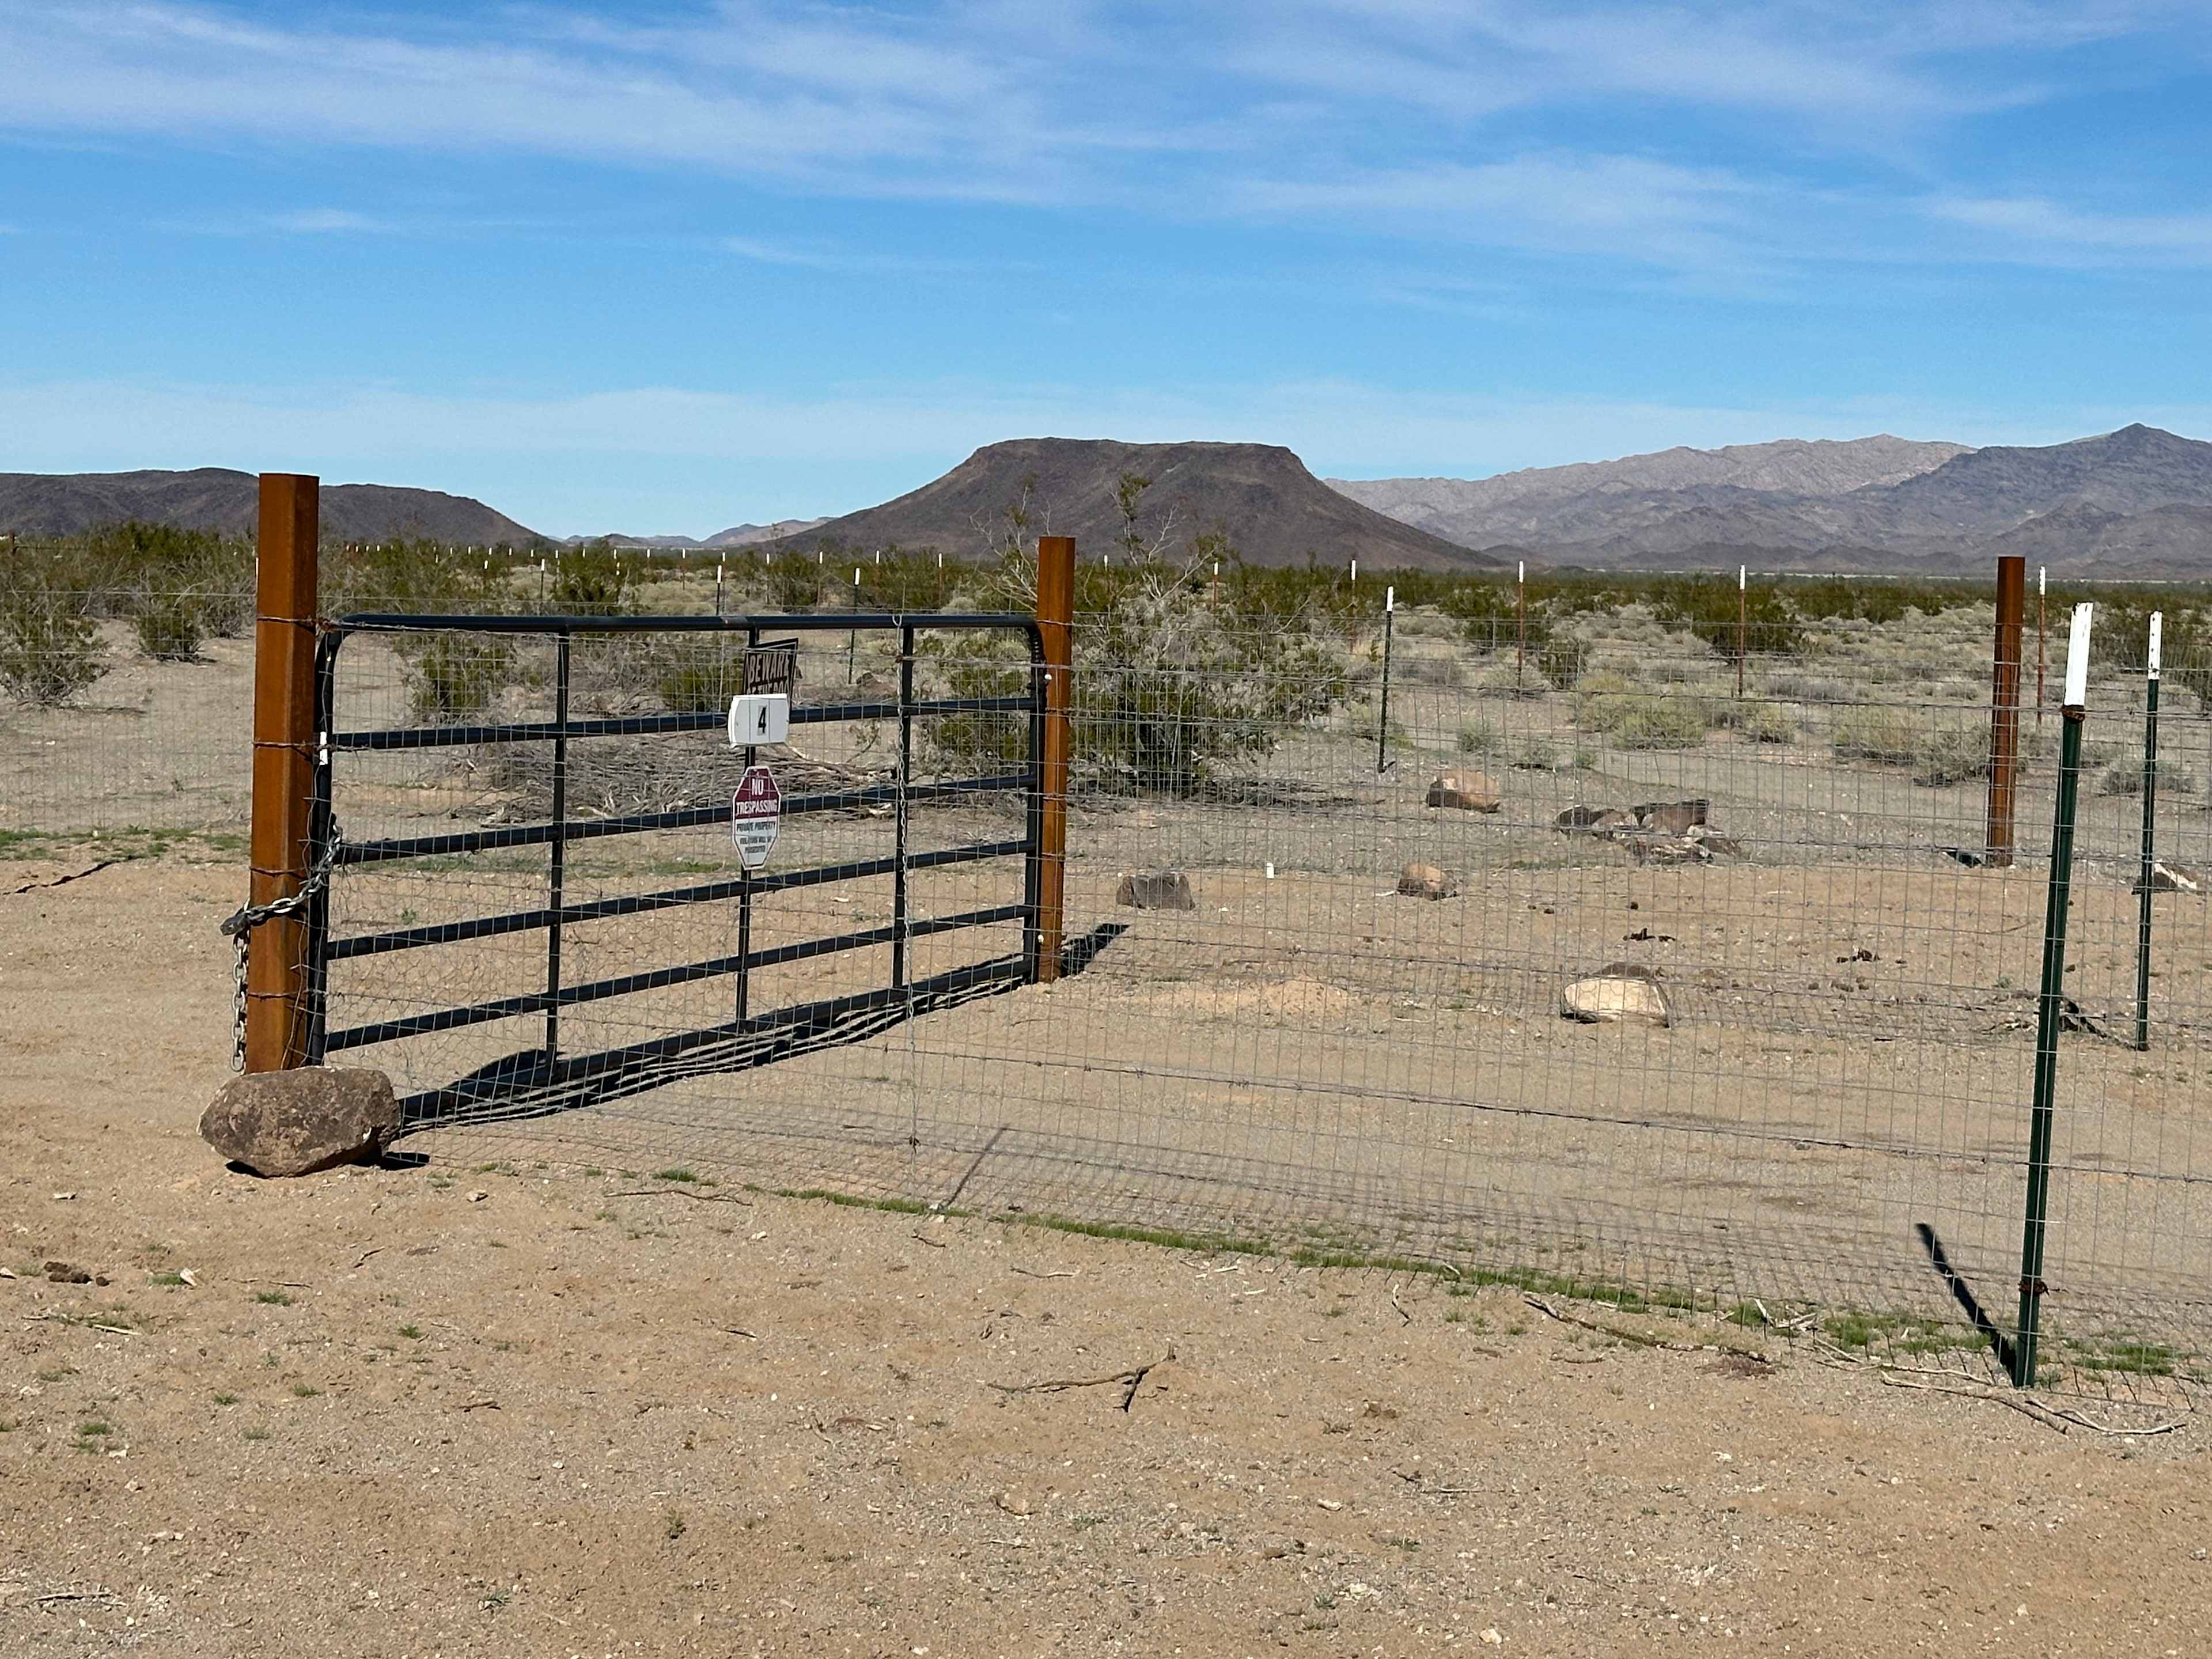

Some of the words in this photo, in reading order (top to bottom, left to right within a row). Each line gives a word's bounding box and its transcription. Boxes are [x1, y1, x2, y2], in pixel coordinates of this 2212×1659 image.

[749, 653, 789, 684] BEWARE
[758, 707, 766, 733] 4
[752, 778, 764, 796] NO
[736, 800, 777, 815] TRESPASSING
